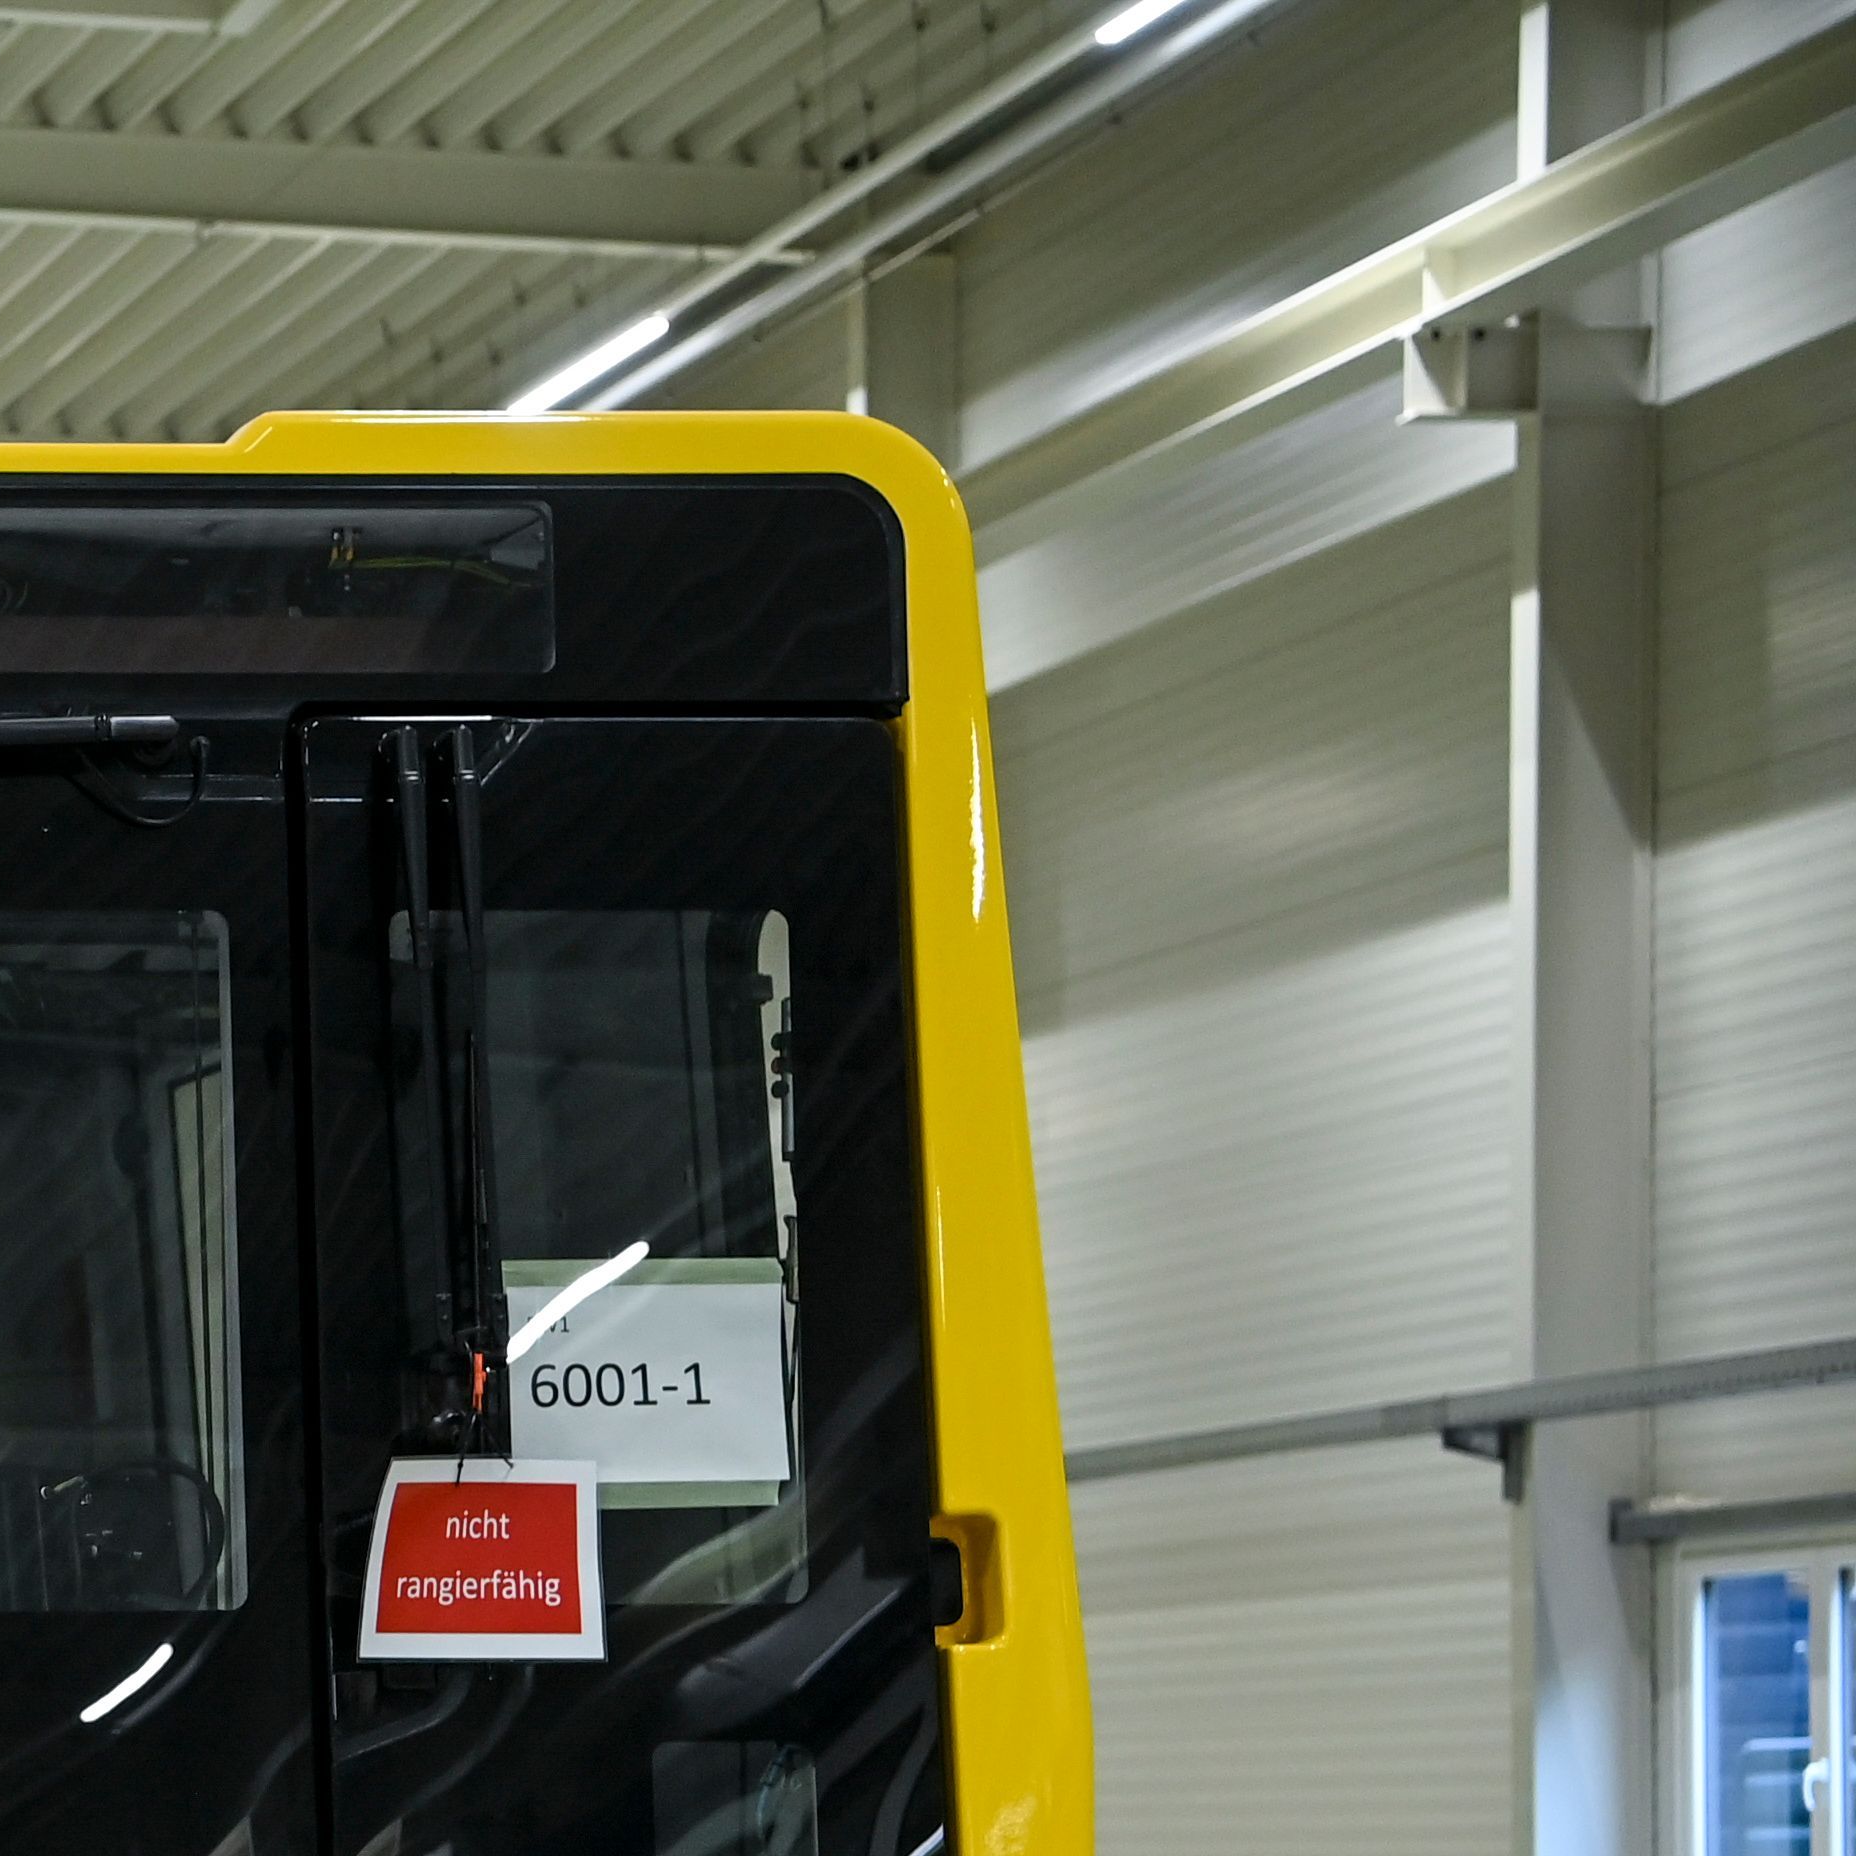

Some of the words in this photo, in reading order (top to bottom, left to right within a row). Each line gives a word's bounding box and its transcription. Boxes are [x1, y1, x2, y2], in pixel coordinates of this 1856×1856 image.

[531, 1362, 711, 1408] 6001-1
[445, 1508, 510, 1540] nicht
[396, 1569, 561, 1606] rangierfähig
